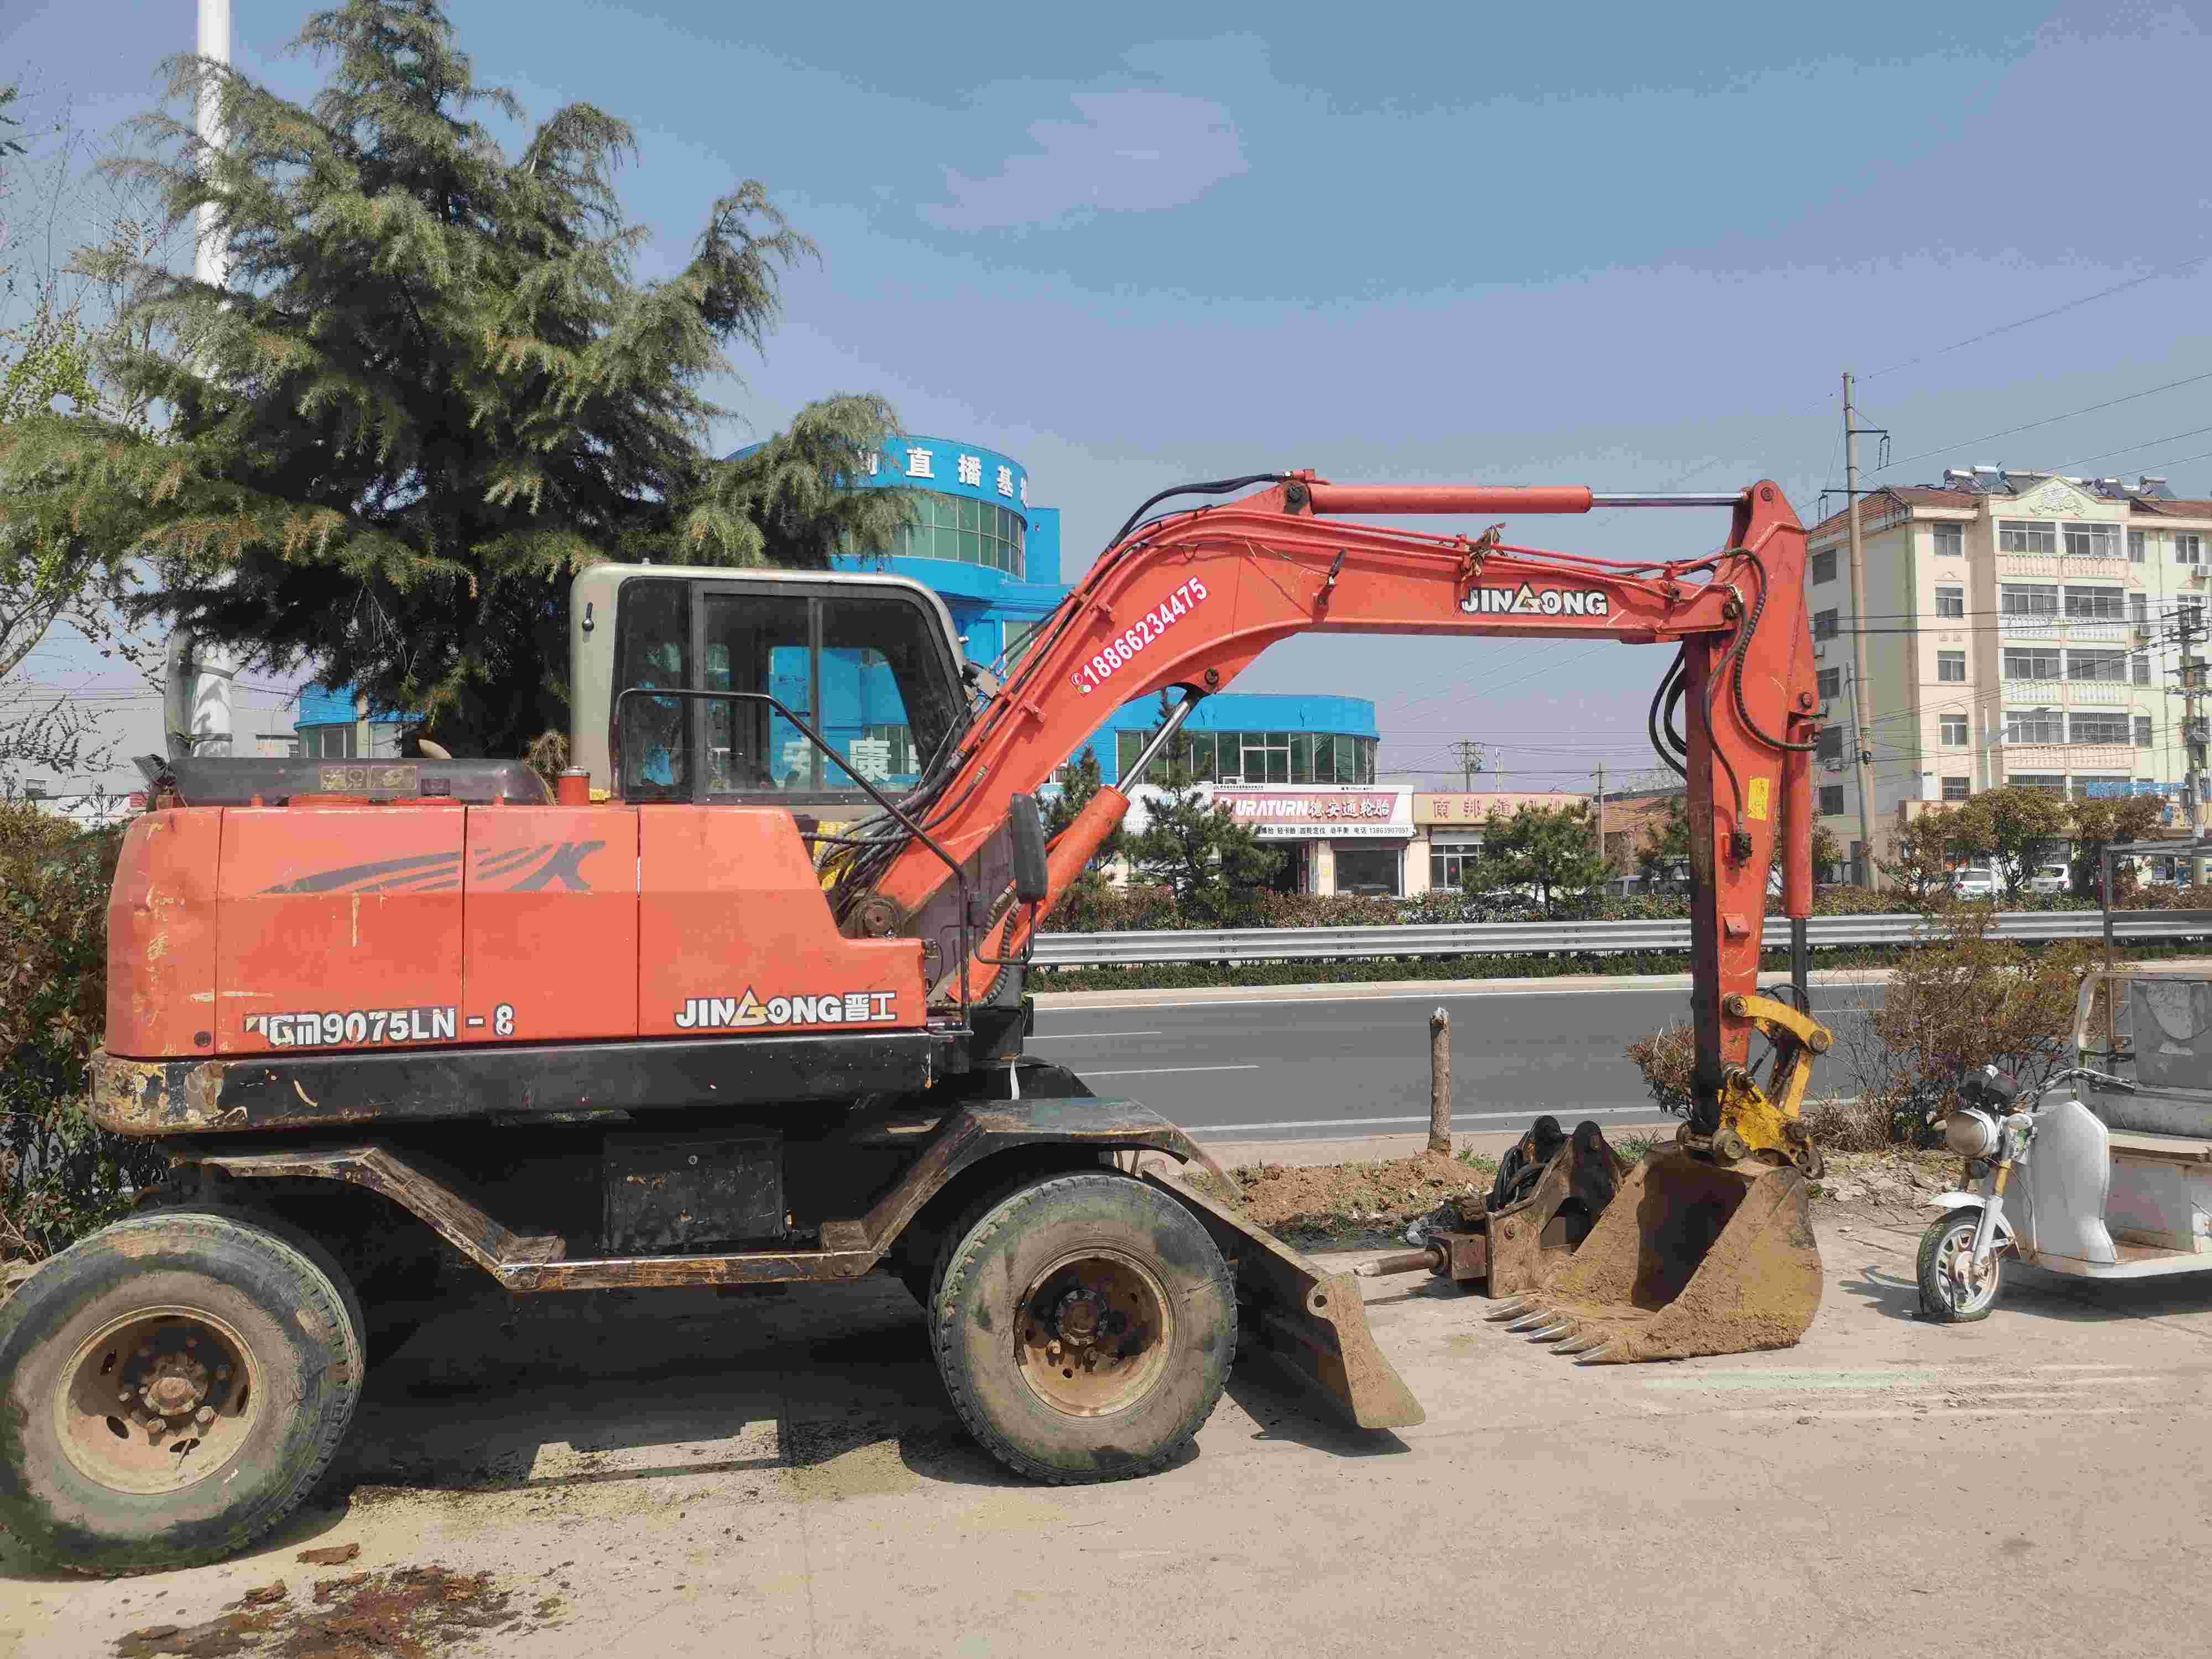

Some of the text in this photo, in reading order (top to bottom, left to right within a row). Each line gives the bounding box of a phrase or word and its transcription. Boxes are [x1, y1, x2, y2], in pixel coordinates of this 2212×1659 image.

[1460, 583, 1609, 615] JINGONG
[1083, 575, 1208, 685] 18866234475
[675, 989, 897, 1027] JINGONG 晋工
